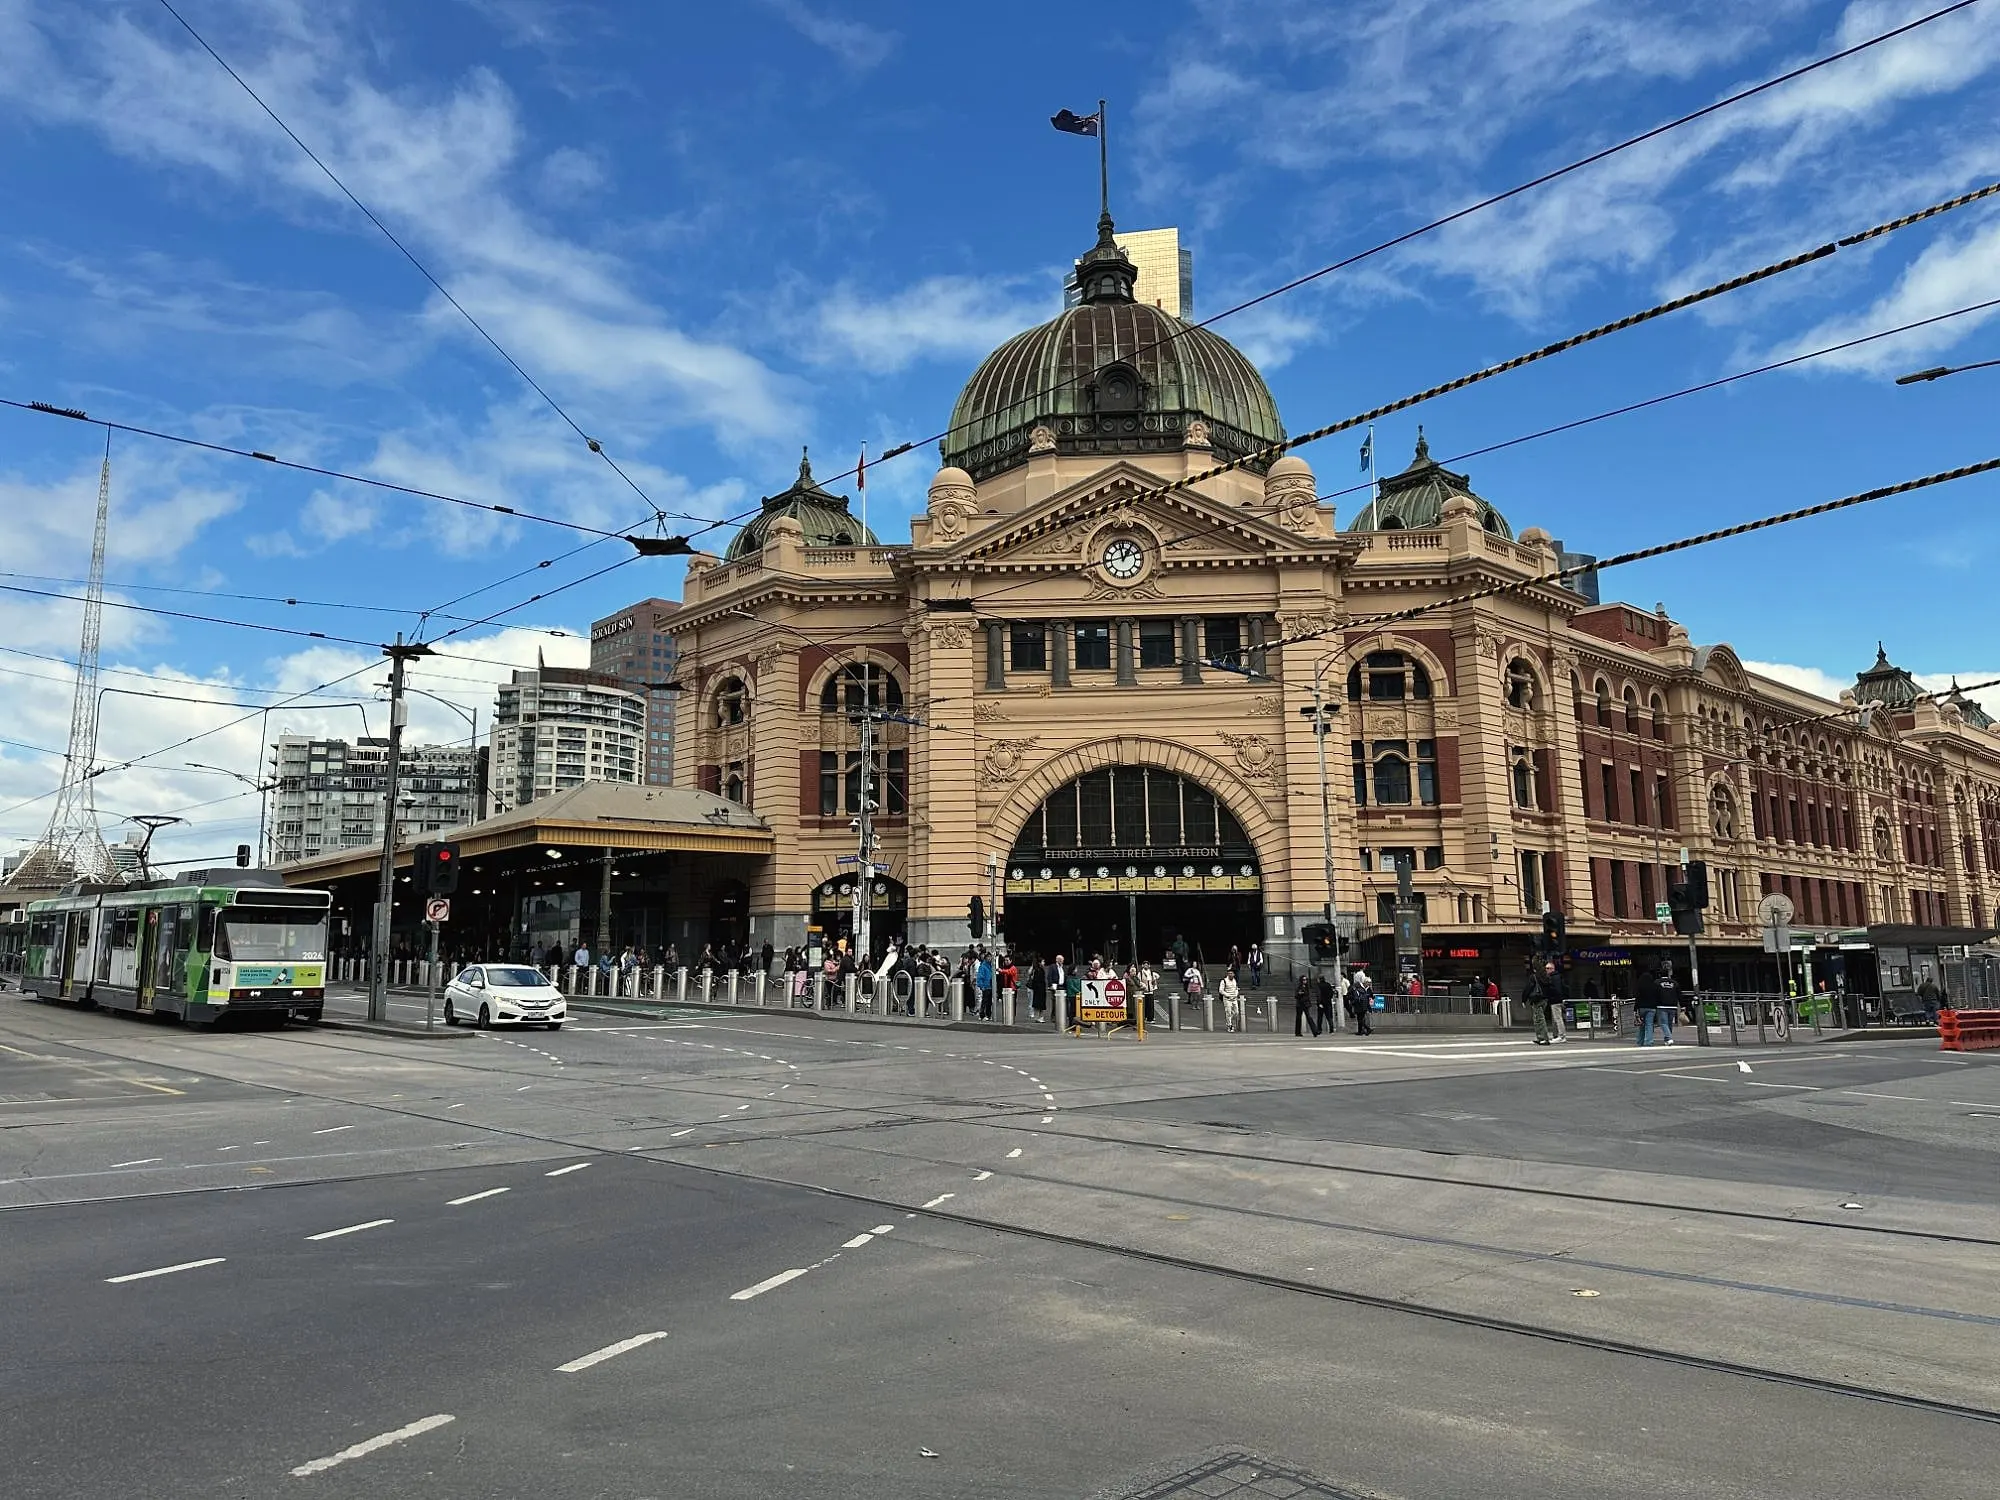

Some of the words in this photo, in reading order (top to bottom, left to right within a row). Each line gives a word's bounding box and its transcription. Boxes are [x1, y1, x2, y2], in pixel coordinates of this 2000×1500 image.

[618, 616, 634, 631] SUN
[1045, 850, 1099, 859] FLINDERS
[1113, 849, 1155, 858] STREET
[1168, 848, 1218, 857] STATION
[1095, 1011, 1125, 1019] DETOUR
